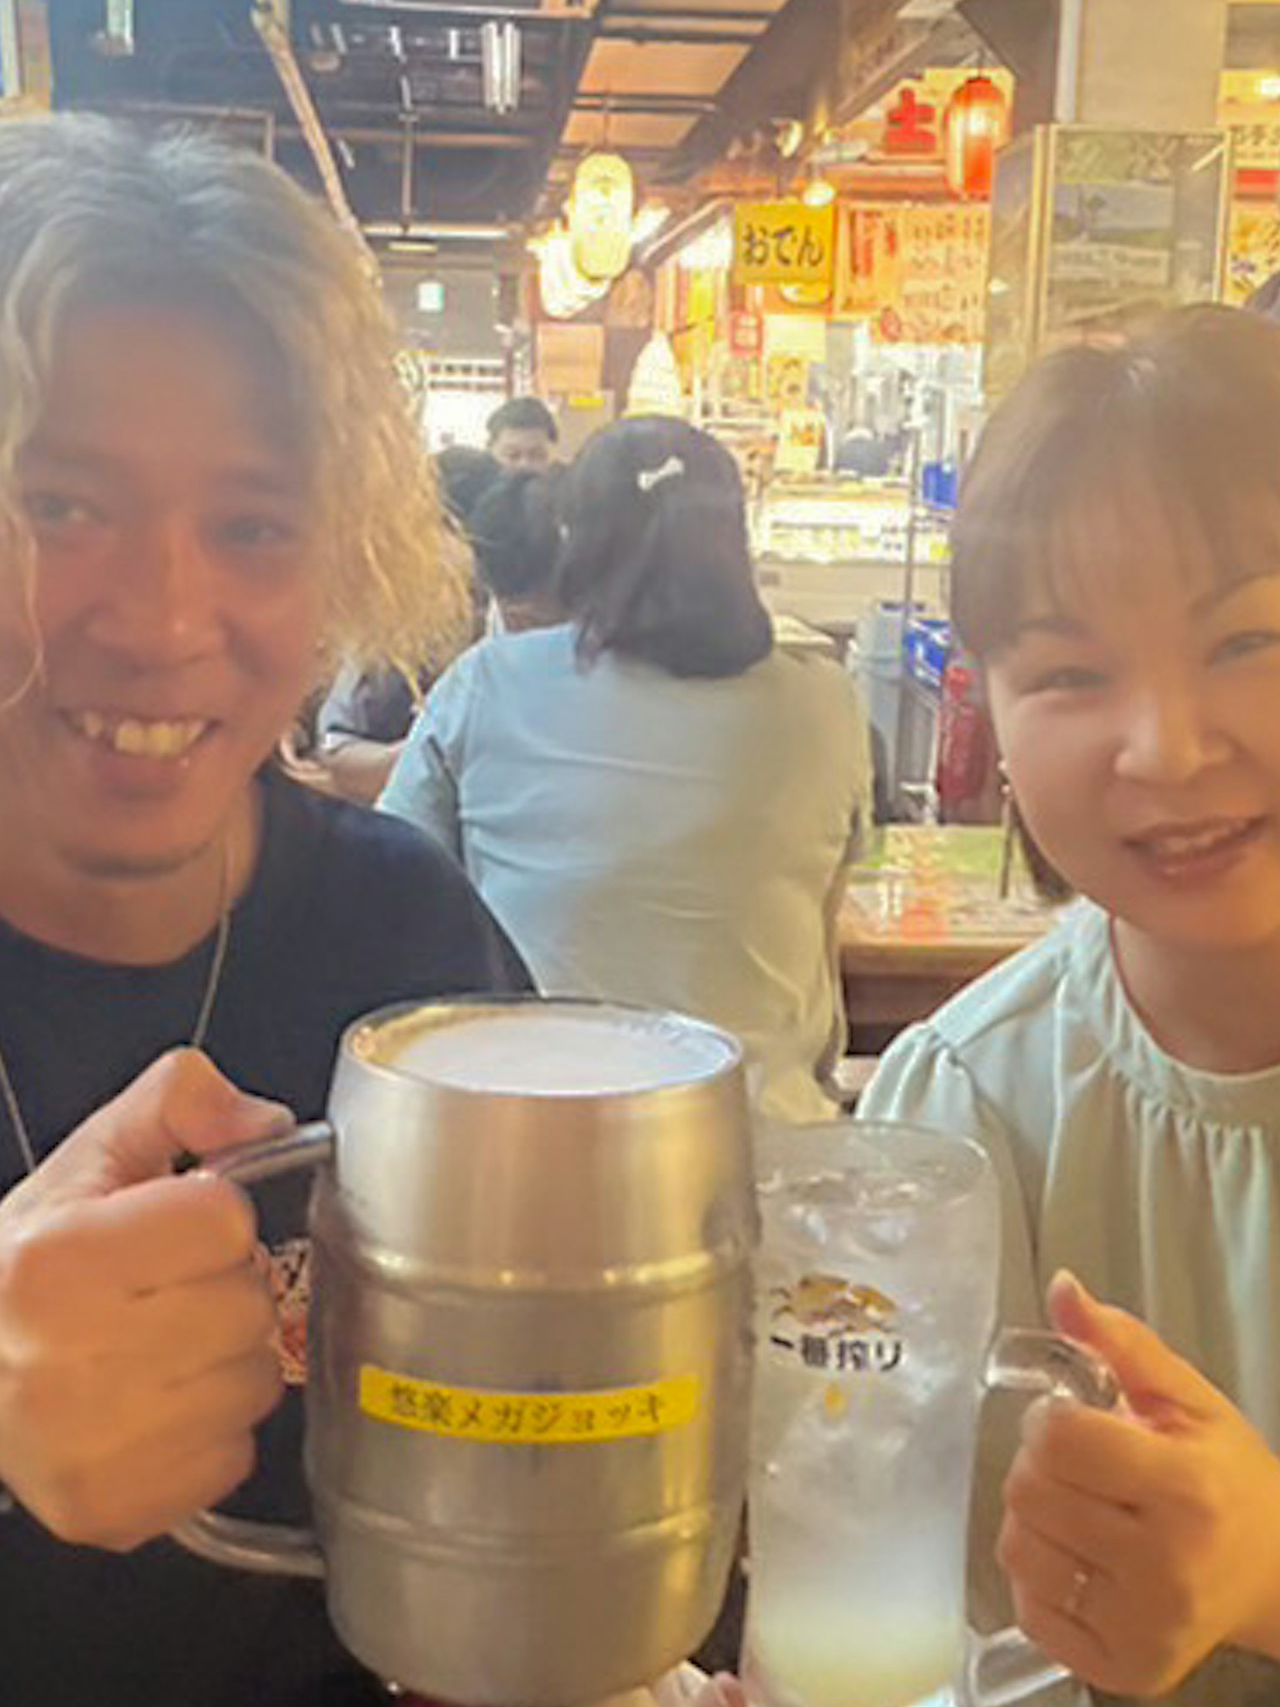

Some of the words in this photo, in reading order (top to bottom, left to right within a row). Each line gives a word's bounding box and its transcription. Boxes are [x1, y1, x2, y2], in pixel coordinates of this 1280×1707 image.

[742, 223, 824, 269] おでん
[770, 1334, 902, 1373] 一番搾り
